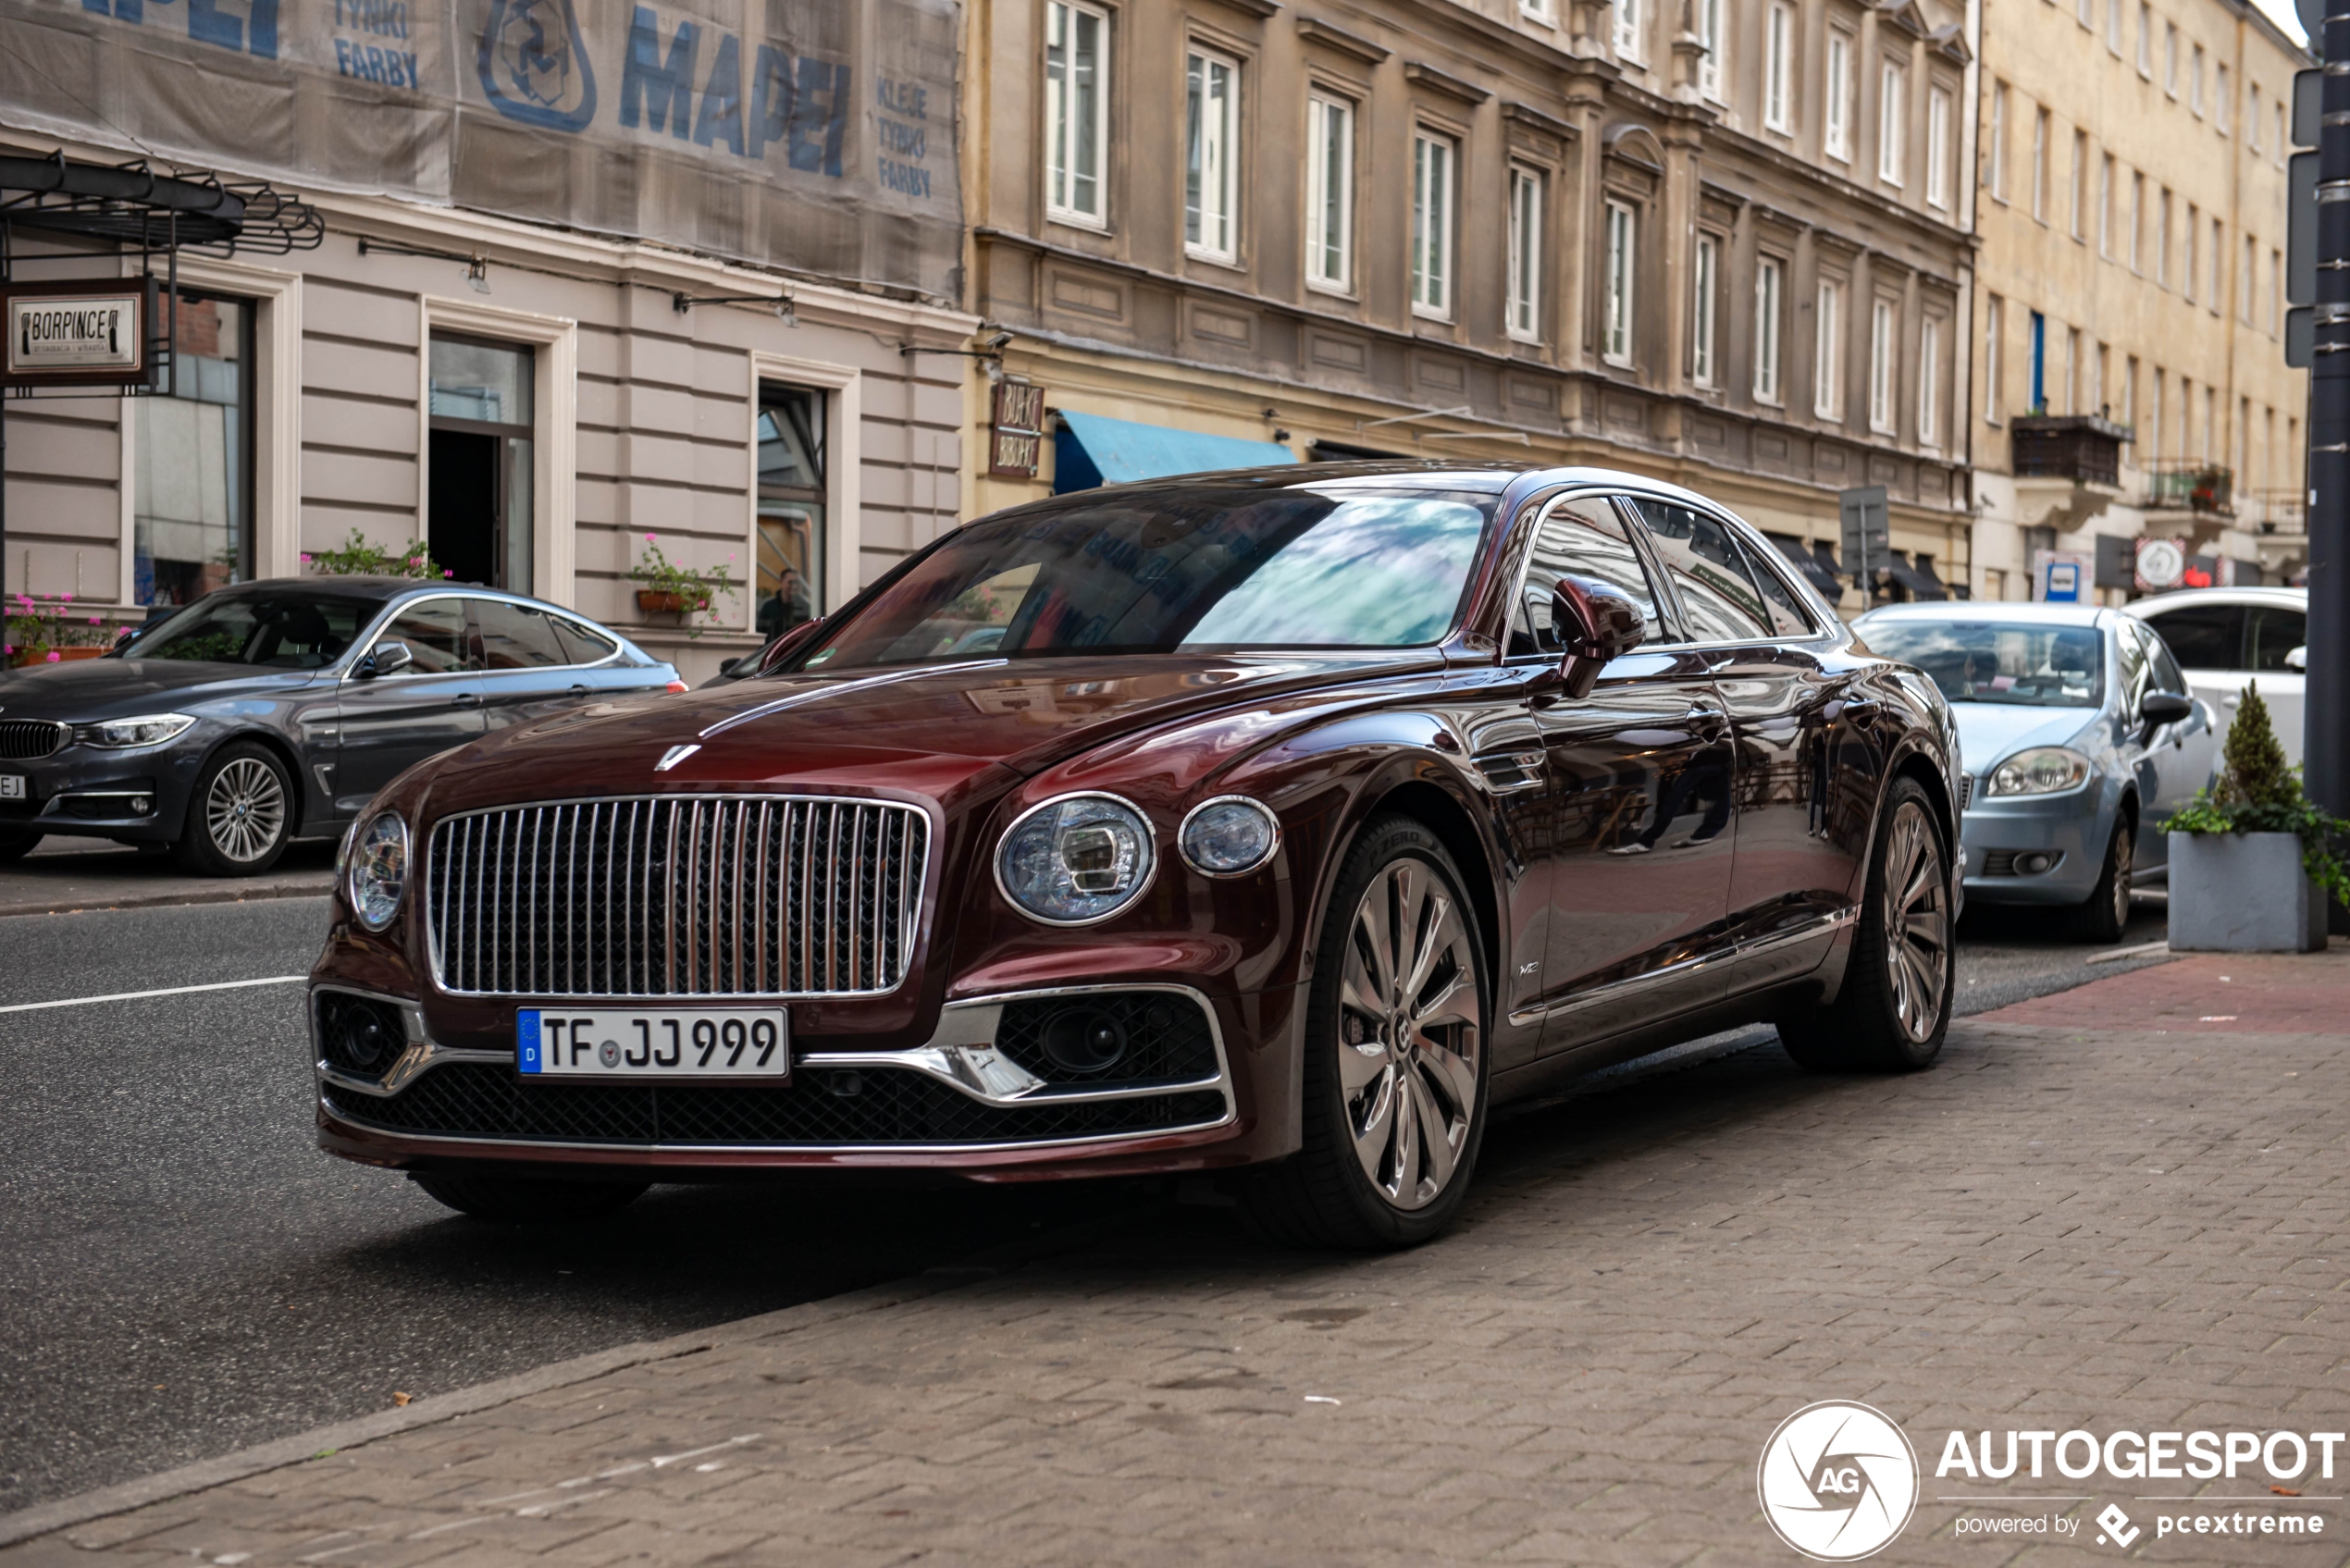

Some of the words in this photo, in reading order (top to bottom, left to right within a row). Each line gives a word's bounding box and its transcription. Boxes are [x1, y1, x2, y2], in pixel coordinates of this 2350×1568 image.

[334, 38, 418, 90] FARBY
[618, 6, 851, 177] MAPEI
[878, 155, 930, 199] FARBY
[32, 310, 106, 340] BORPINCE
[1, 777, 19, 796] EJ
[1380, 831, 1420, 855] ZERO
[526, 1049, 535, 1061] D
[544, 1019, 594, 1066] TF
[625, 1019, 680, 1066] JJ
[692, 1019, 777, 1067] 999
